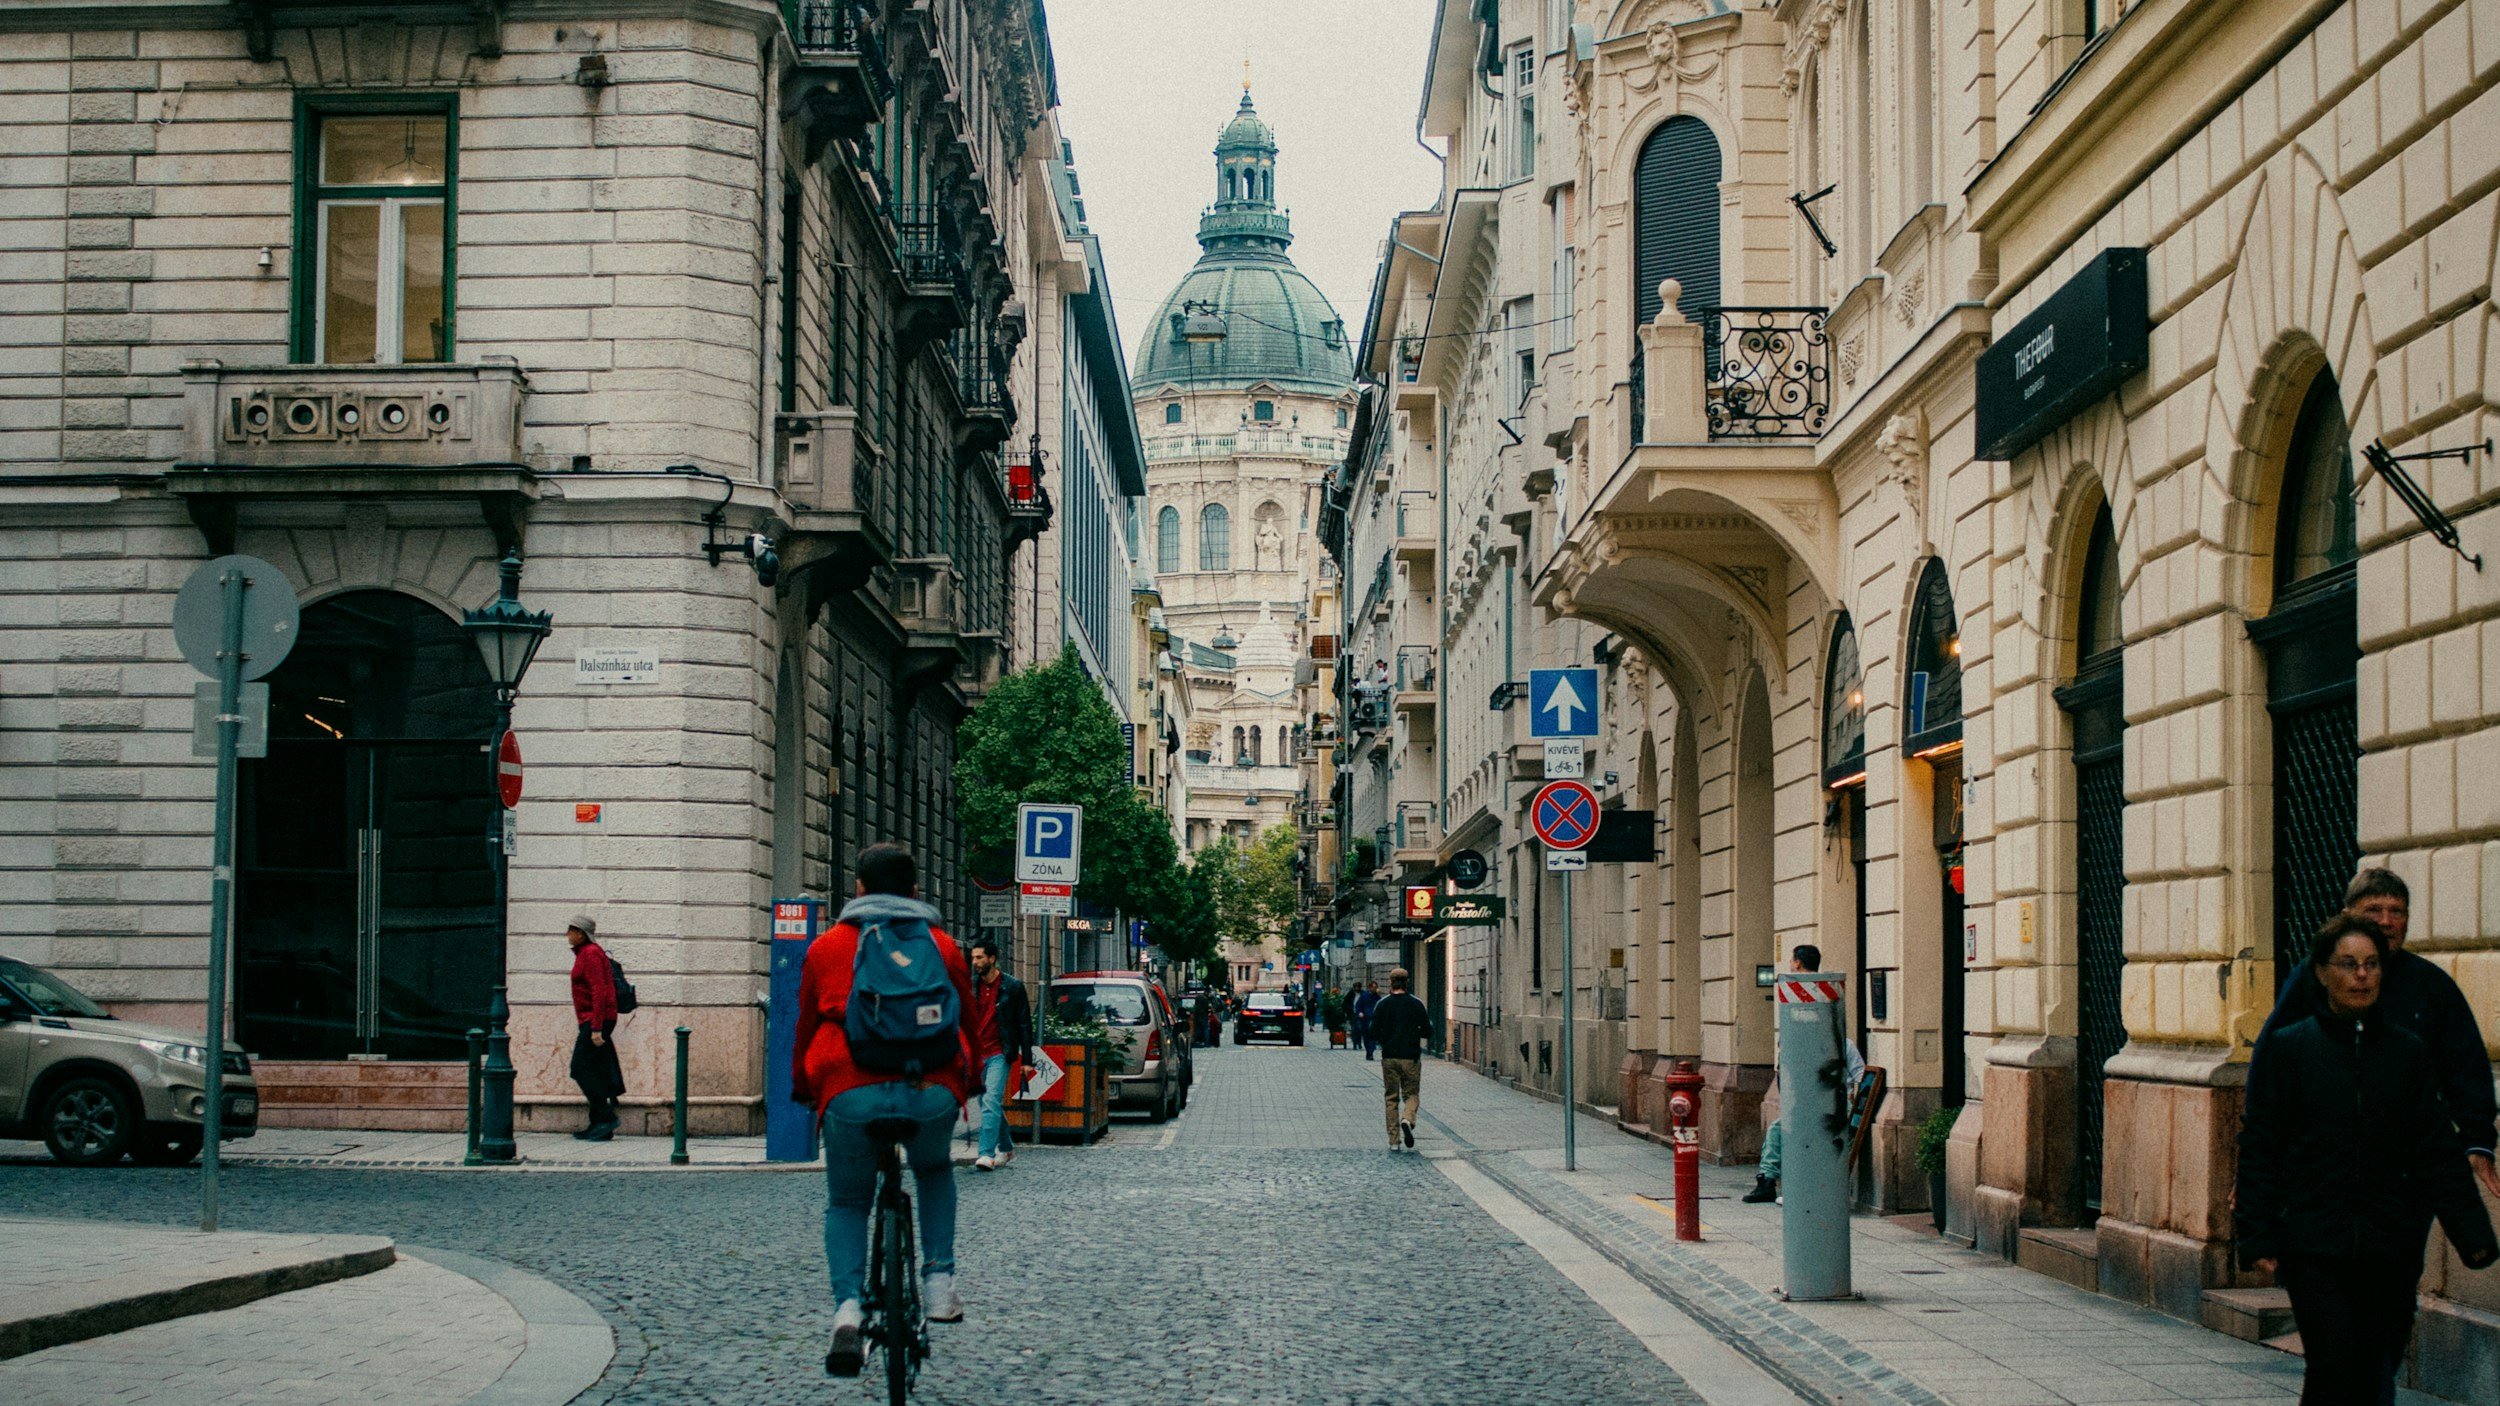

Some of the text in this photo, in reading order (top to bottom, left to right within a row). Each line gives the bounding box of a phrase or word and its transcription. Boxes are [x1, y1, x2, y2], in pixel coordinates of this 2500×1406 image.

[580, 658, 654, 671] Dalszínház utca
[1548, 745, 1580, 754] KIVÉVE
[1034, 816, 1063, 854] P
[1032, 863, 1062, 875] ZÓNA
[780, 904, 803, 917] 3061
[1440, 906, 1492, 918] Christofle
